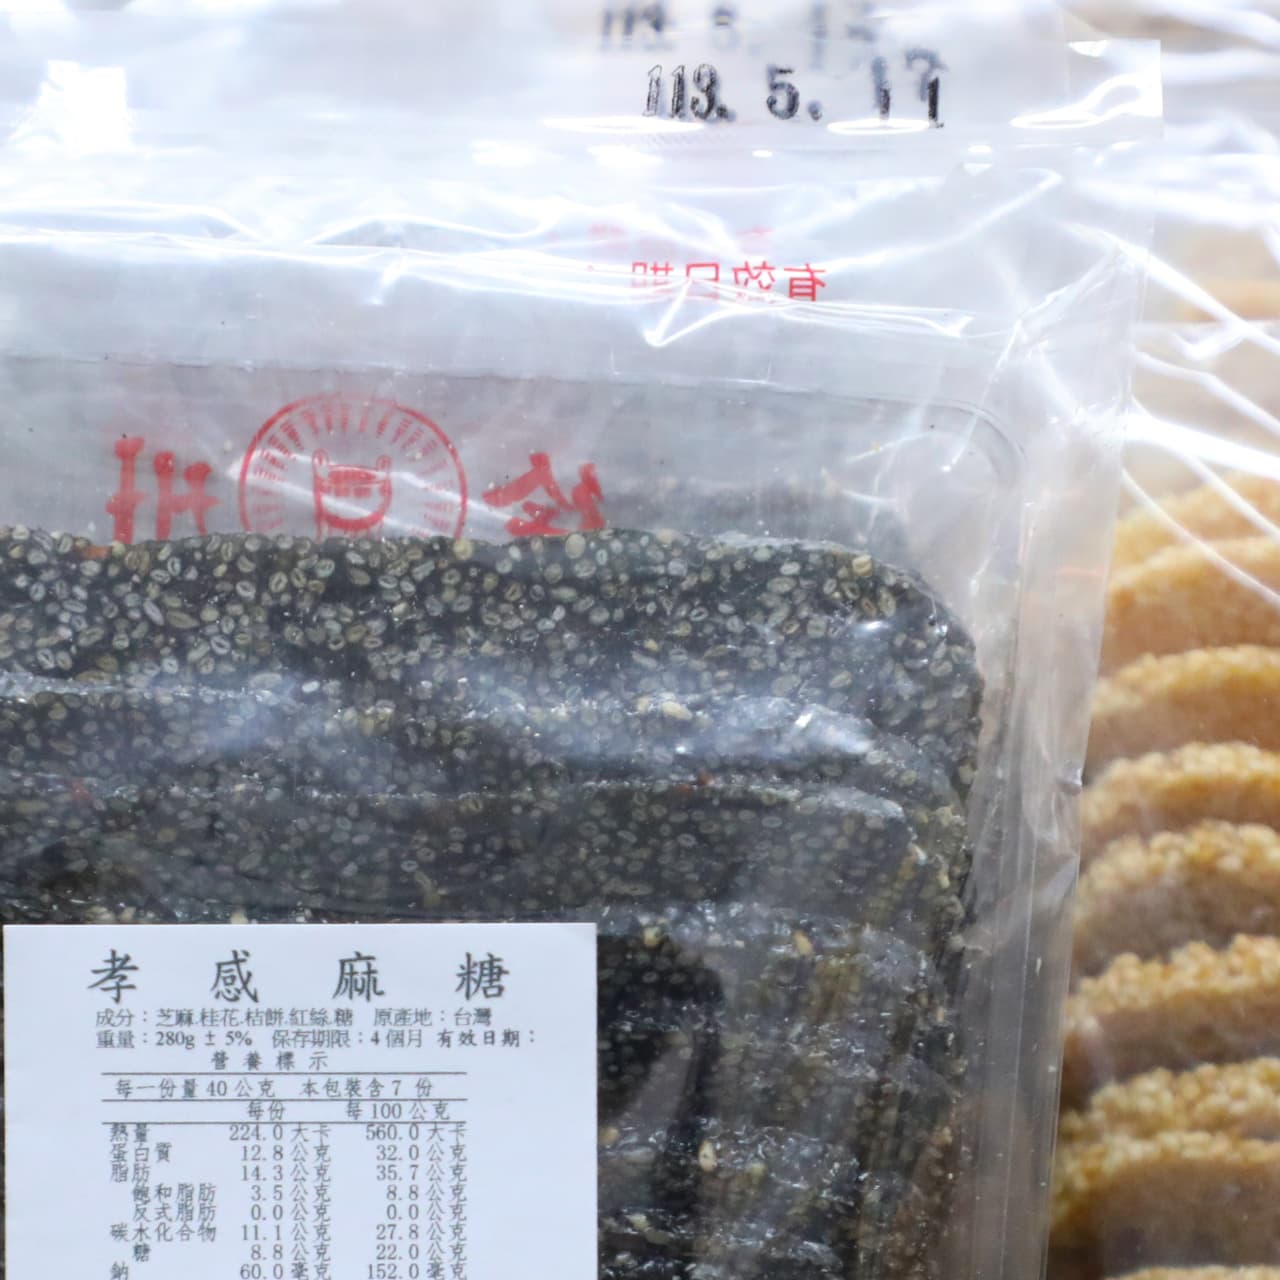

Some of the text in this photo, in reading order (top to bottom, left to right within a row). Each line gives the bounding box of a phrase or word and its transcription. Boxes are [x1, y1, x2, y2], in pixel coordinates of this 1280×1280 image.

[87, 948, 510, 1003] 孝感麻糖
[210, 1050, 329, 1071] 營養標示
